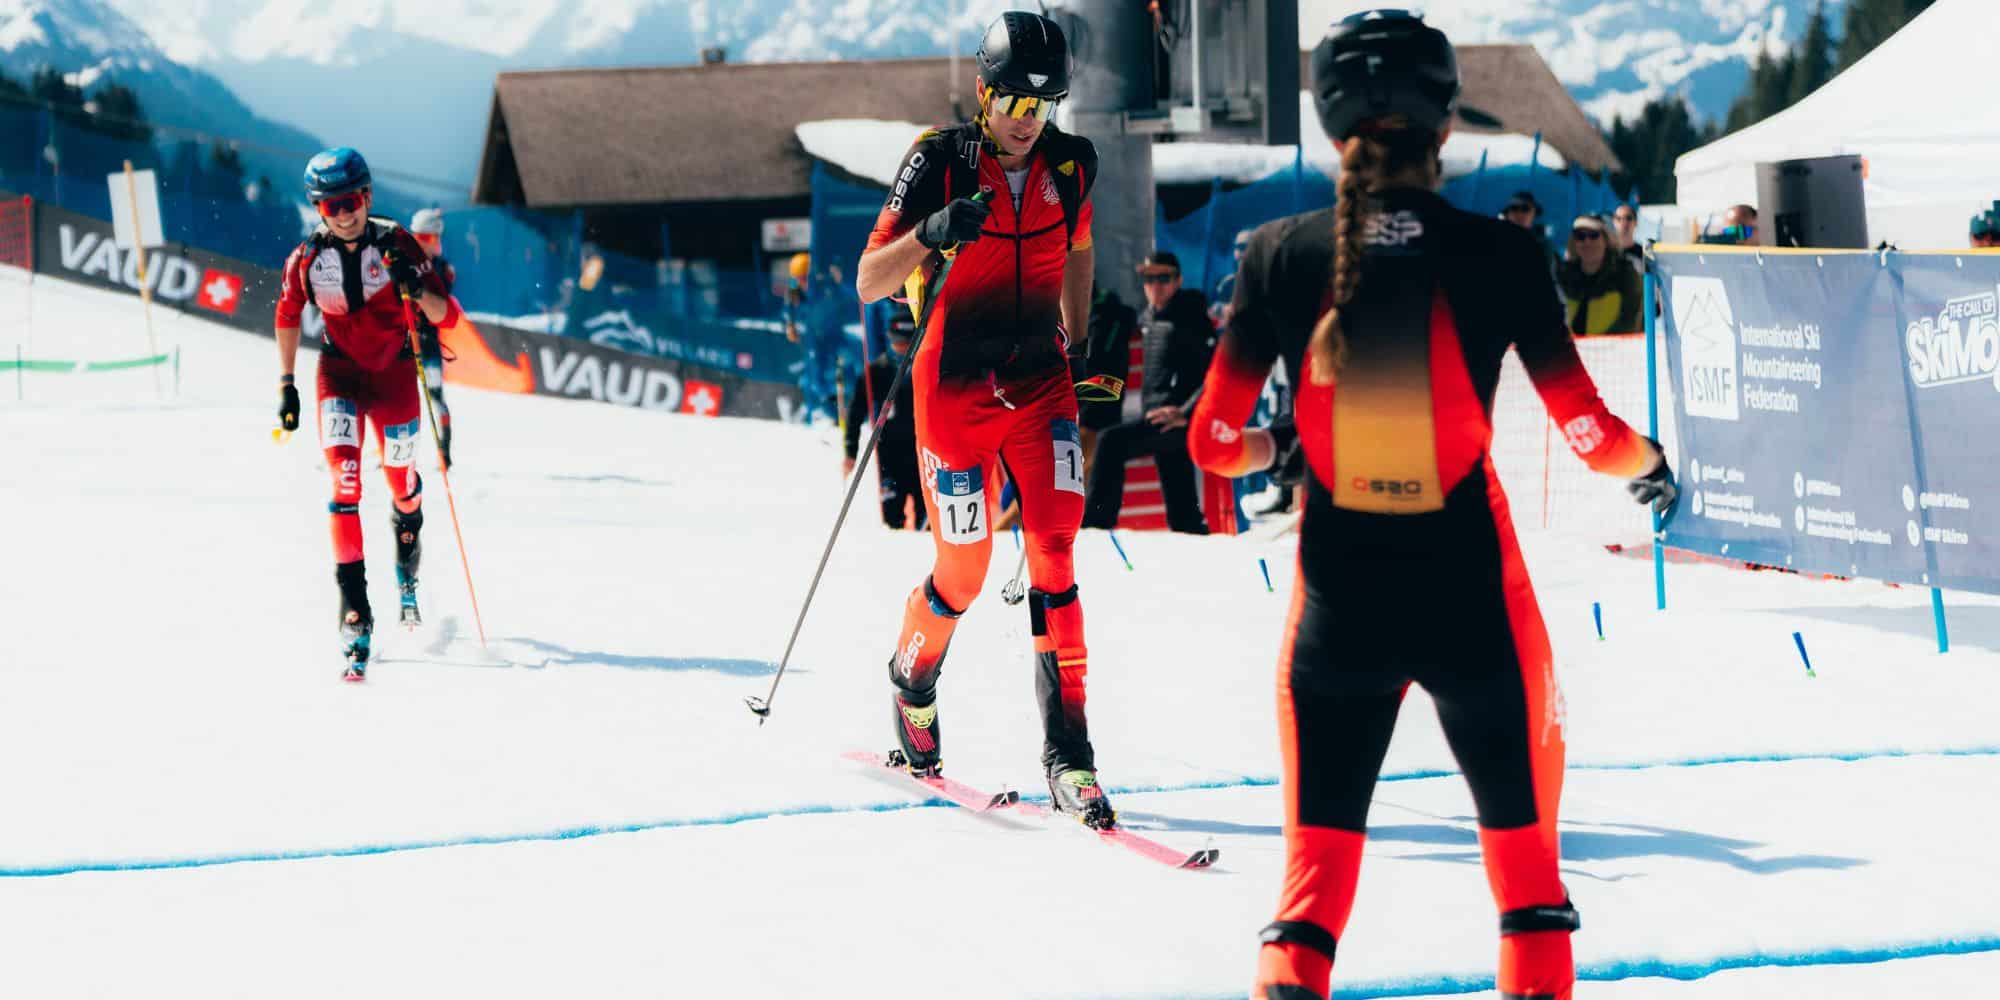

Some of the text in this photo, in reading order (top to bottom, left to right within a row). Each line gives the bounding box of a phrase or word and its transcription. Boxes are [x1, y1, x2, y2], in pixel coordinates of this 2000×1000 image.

[59, 224, 199, 300] VAUD
[1739, 321, 1821, 351] International Ski
[539, 347, 683, 414] VAUD
[1689, 363, 1732, 406] ISMF
[1742, 352, 1822, 390] Mountaineering
[1743, 383, 1799, 413] Federation
[339, 458, 358, 496] SUI
[946, 501, 980, 536] 1.2
